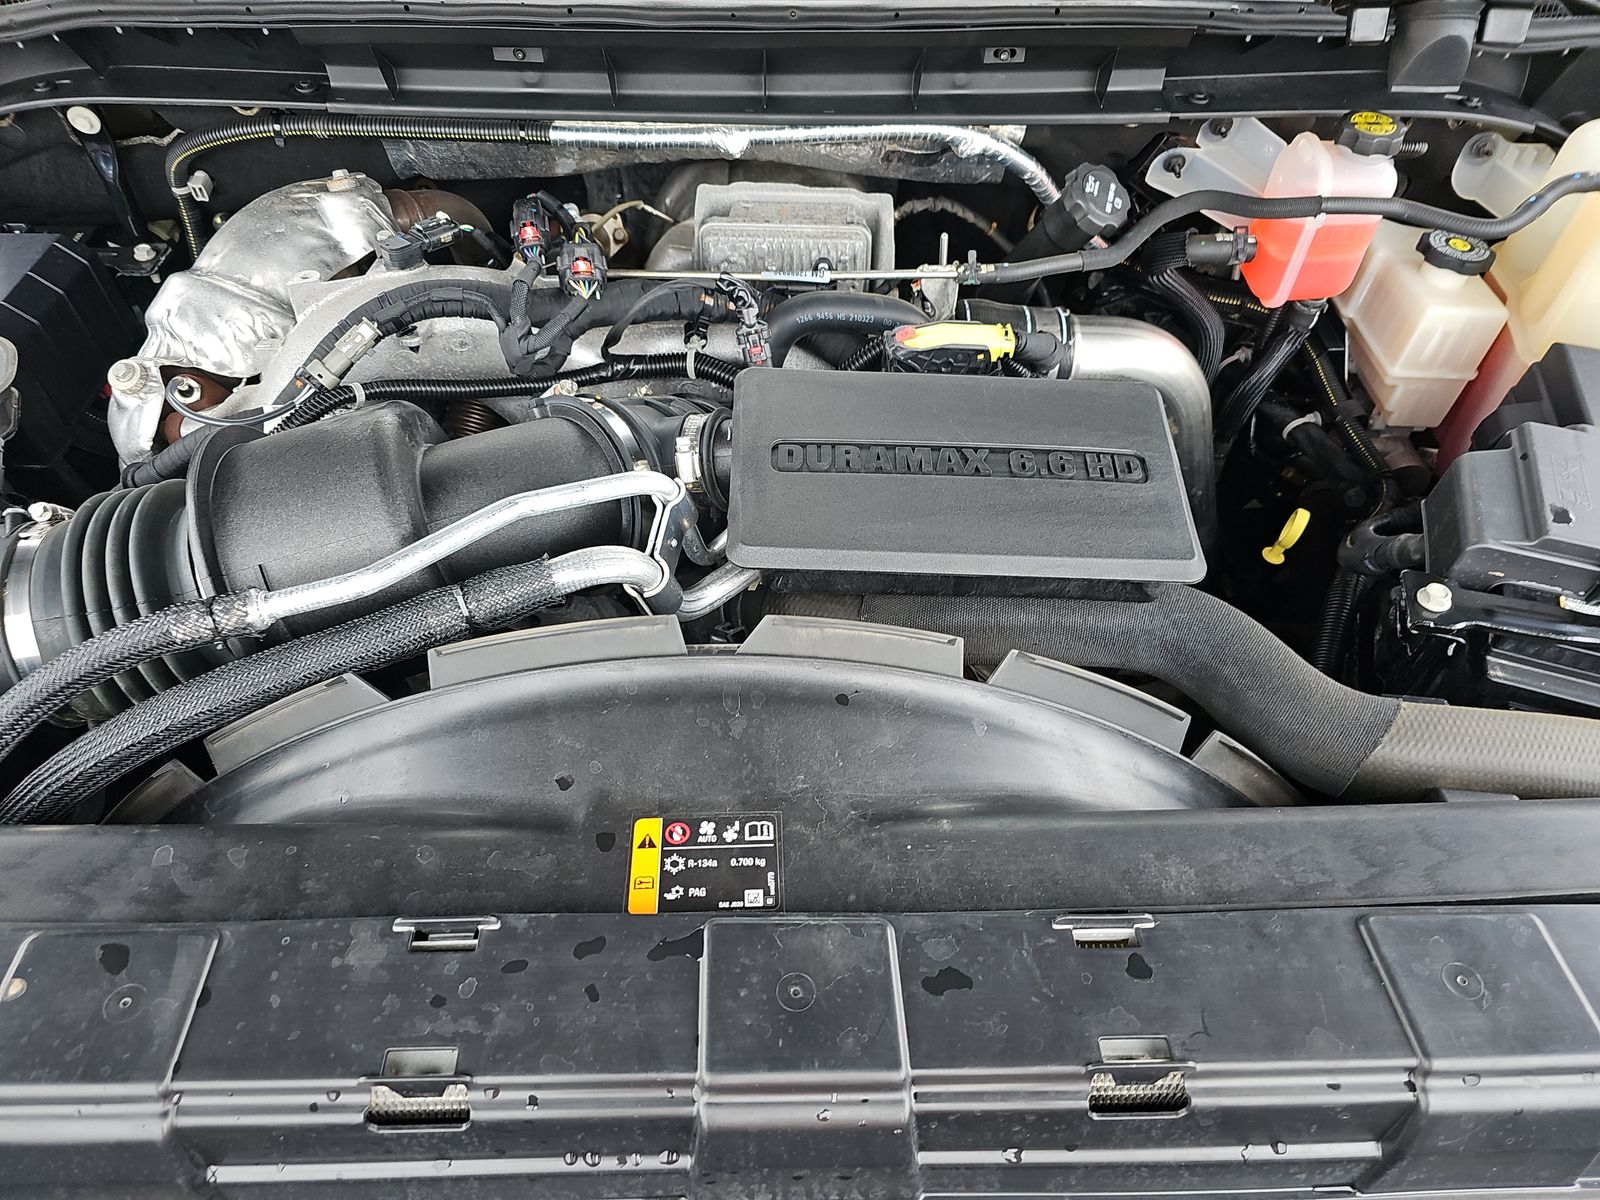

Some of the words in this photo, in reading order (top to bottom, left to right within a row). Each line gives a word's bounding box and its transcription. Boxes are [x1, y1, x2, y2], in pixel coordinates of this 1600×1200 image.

[796, 313, 813, 324] 1266
[816, 311, 833, 320] 9456
[837, 312, 846, 321] HS
[849, 313, 875, 323] 210323
[777, 444, 993, 475] DURAMAX
[1009, 450, 1077, 477] 6.6
[1085, 453, 1143, 481] HD
[697, 834, 718, 843] AUTO
[687, 858, 718, 868] R-134a
[730, 857, 754, 867] 0.700
[755, 857, 766, 868] kg
[688, 887, 707, 897] PAG
